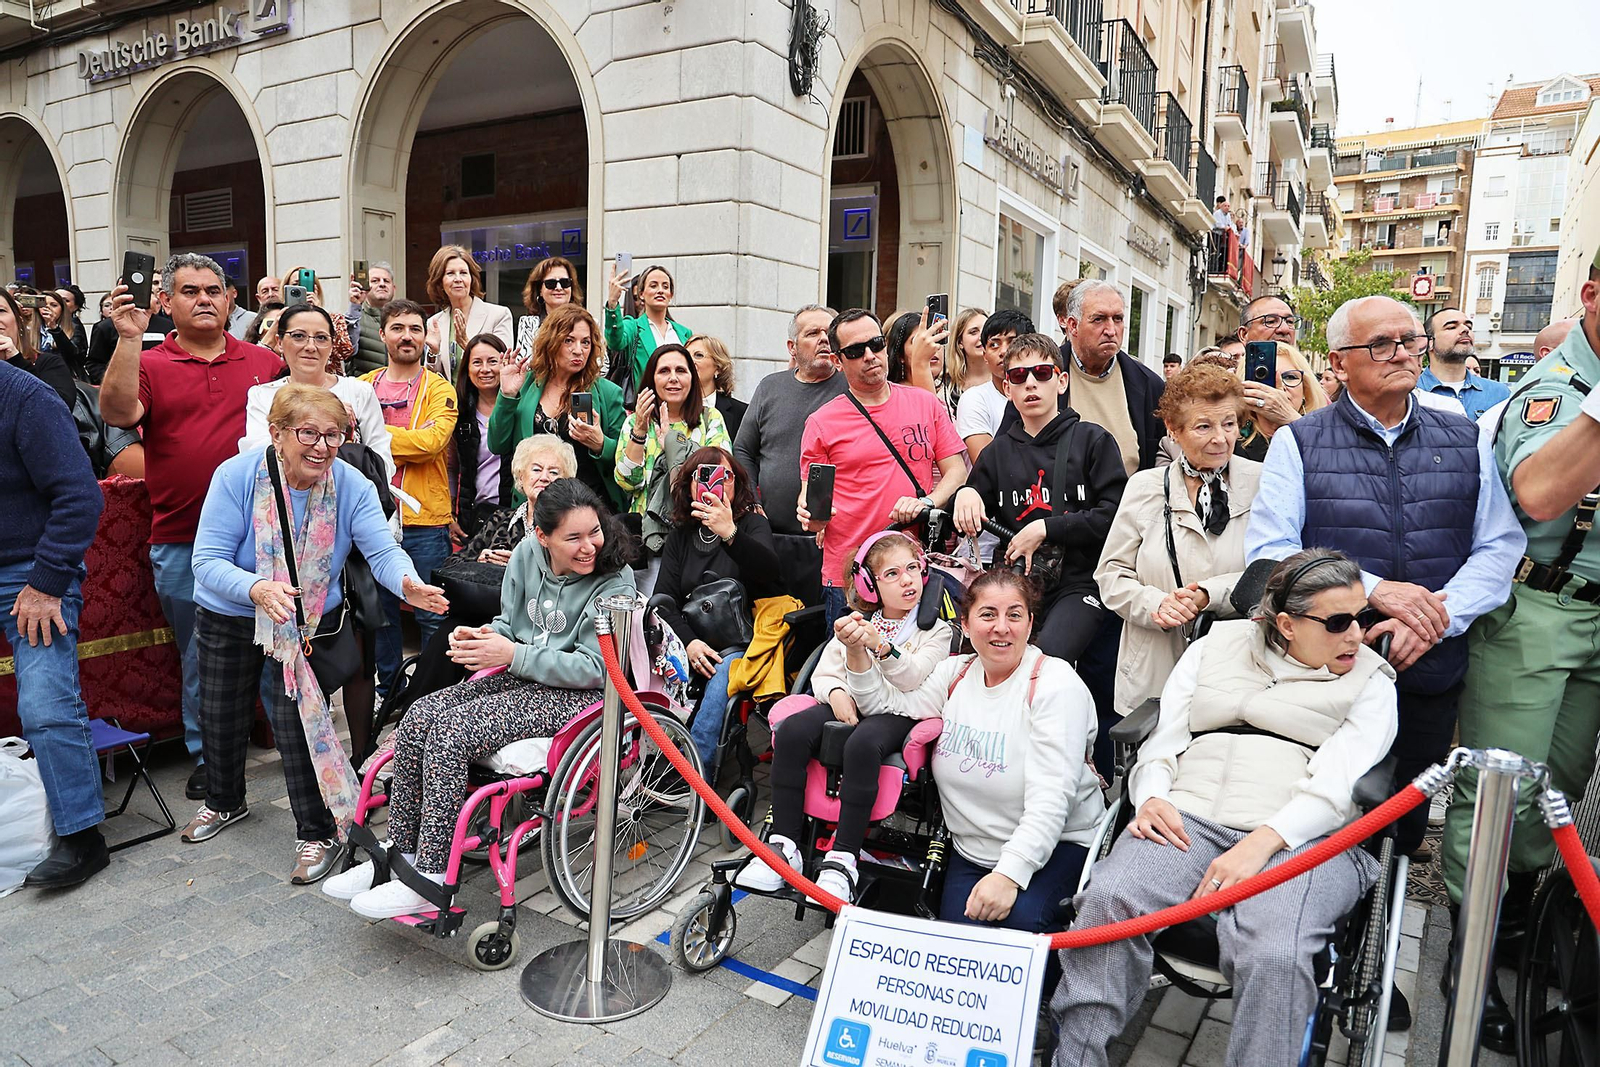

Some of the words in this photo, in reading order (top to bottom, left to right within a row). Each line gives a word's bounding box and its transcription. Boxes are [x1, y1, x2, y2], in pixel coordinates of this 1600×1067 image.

[77, 29, 168, 79] Deutsche
[175, 6, 237, 52] Bank
[515, 242, 550, 260] Bank
[998, 484, 1086, 507] JORDN
[959, 740, 1008, 779] Diego
[849, 939, 921, 969] ESPACIO
[924, 953, 1023, 985] RESERVADO
[876, 975, 954, 1004] PERSONAS
[957, 990, 988, 1010] CON
[849, 998, 928, 1029] MOVILIDAD
[931, 1015, 1002, 1044] REDUCIDA
[826, 1051, 861, 1066] RESERVADO
[878, 1036, 914, 1054] Huelva
